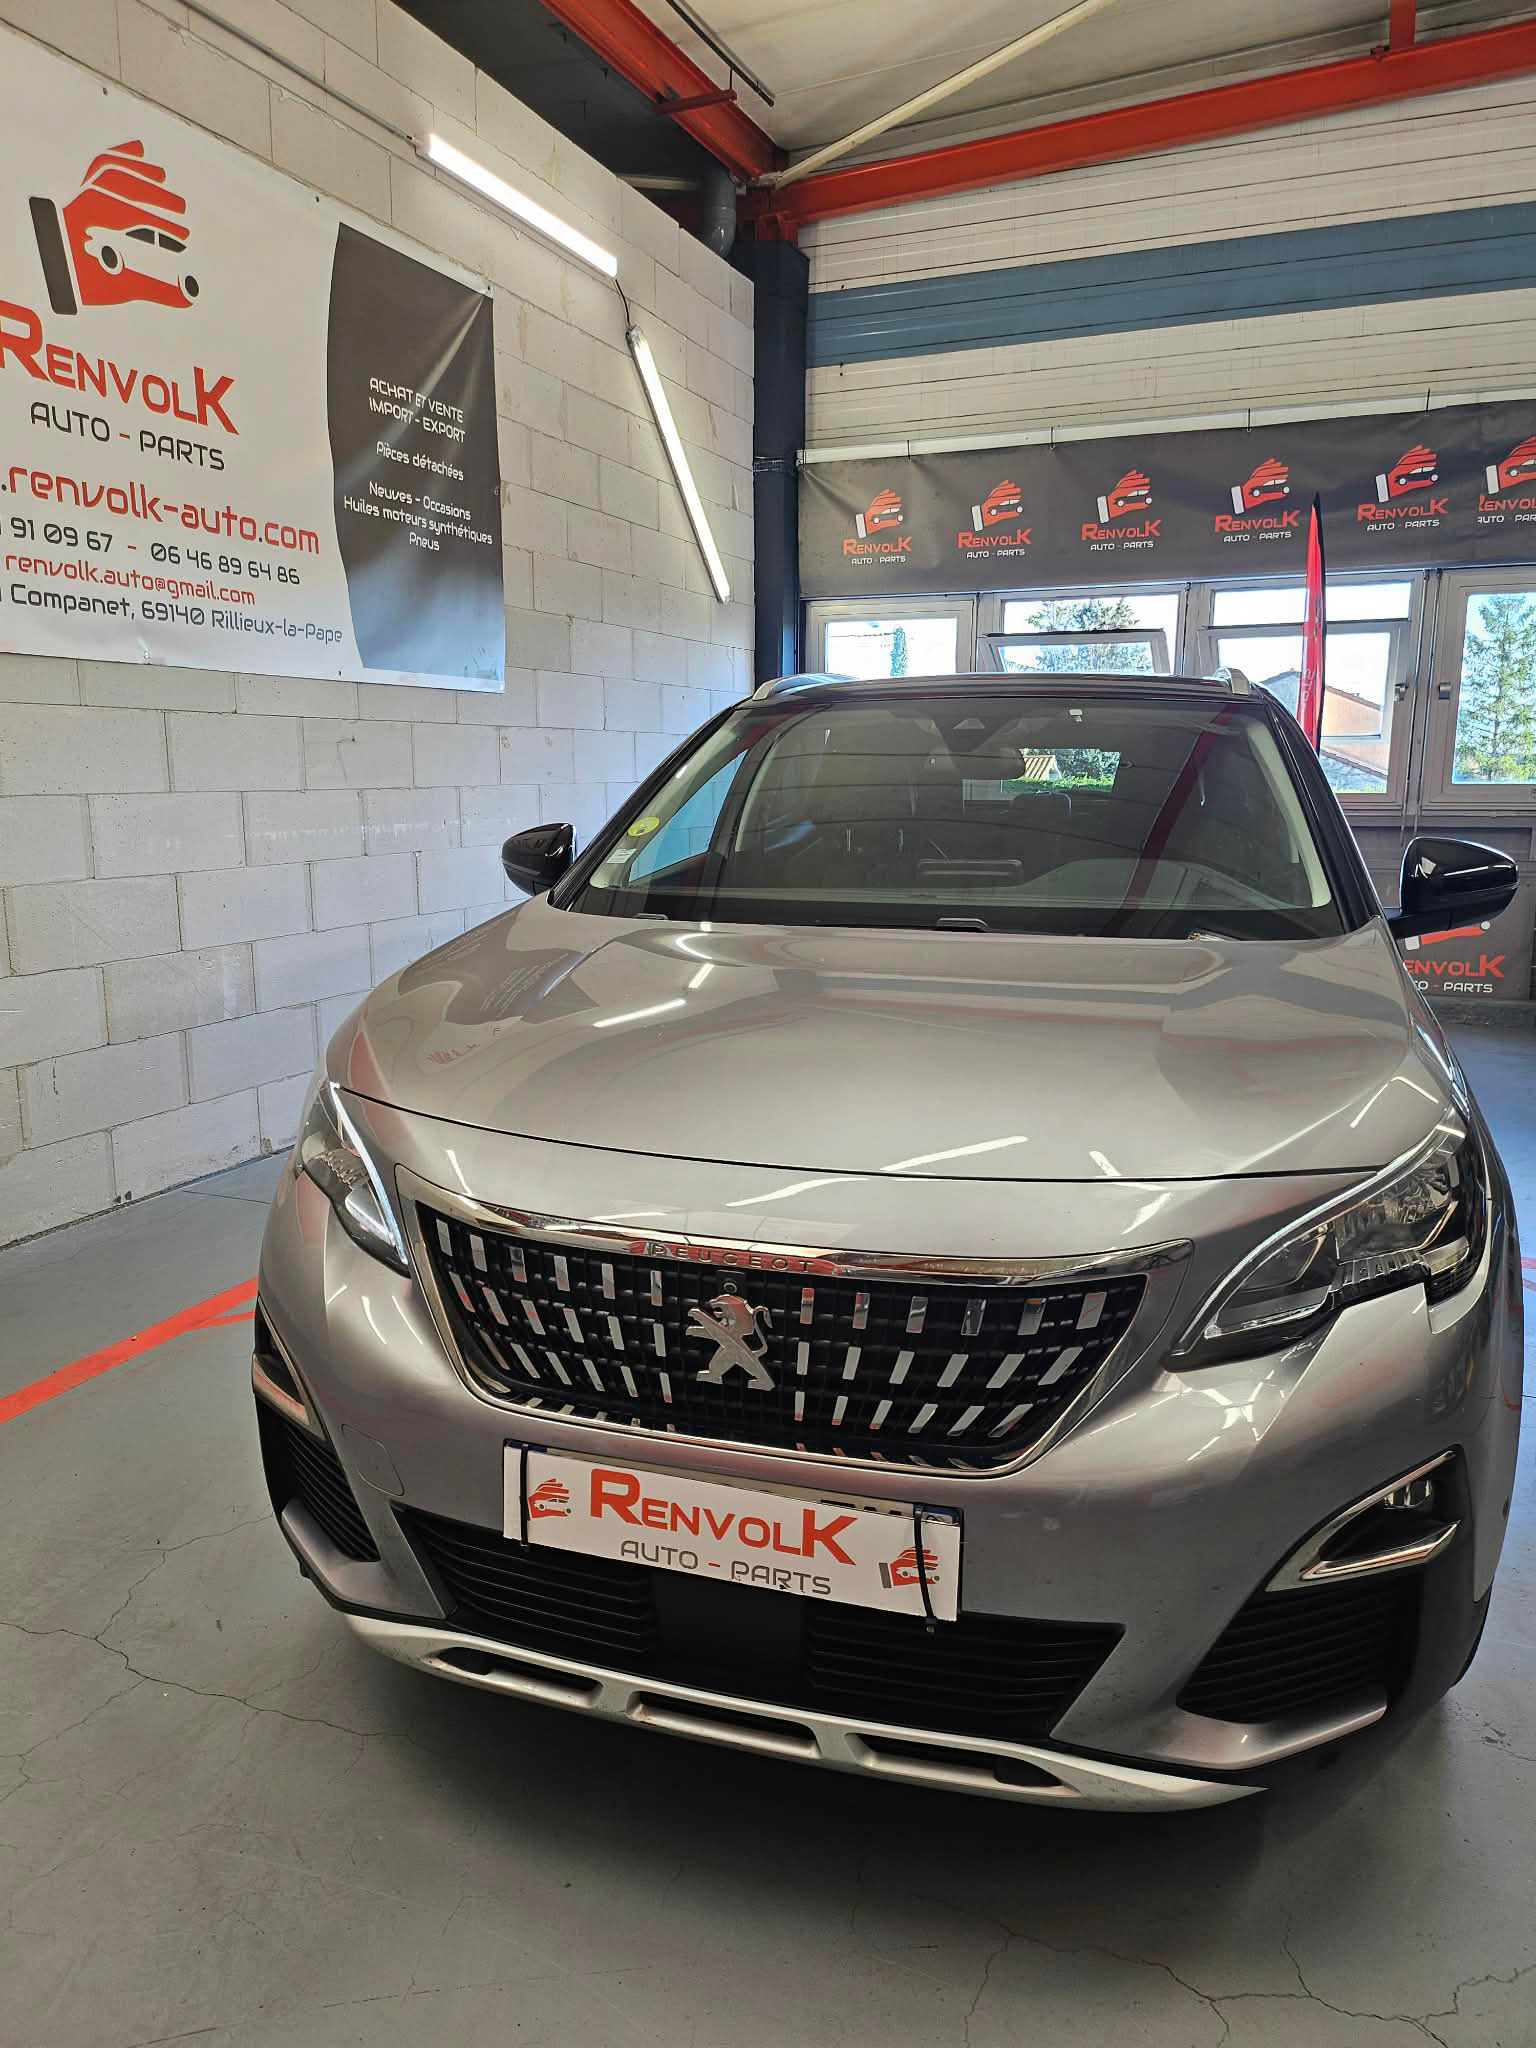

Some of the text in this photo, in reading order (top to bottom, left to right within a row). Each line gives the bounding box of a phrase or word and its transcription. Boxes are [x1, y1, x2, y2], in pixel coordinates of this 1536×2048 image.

[0, 300, 240, 435] RENVOLK
[369, 377, 464, 423] ACHAT ET VENTE
[369, 397, 414, 424] IMPORT
[423, 417, 466, 443] EXPORT
[31, 402, 110, 442] AUTO
[139, 430, 225, 471] PARTS
[376, 441, 464, 481] Pièces détachées
[369, 481, 413, 504] Neuves
[423, 496, 472, 521] Occasions
[1356, 498, 1448, 522] RENVOLK
[344, 495, 493, 545] Huiles moteurs synthétiques
[1081, 520, 1161, 541] RENVOLK
[1214, 510, 1300, 533] RENVOLK
[1367, 523, 1395, 531] AUTO
[1405, 520, 1440, 529] PARTS
[11, 517, 34, 540] 91
[44, 523, 78, 546] 09
[87, 531, 113, 552] 67
[151, 543, 181, 564] 06
[186, 549, 212, 570] 46
[218, 555, 242, 575] 89
[248, 561, 272, 580] 64
[277, 566, 300, 584] 86
[409, 532, 440, 550] Pneus
[842, 536, 912, 555] RENVOLK
[957, 528, 1032, 549] RENVOLK
[1090, 543, 1115, 551] AUTO
[1123, 541, 1154, 550] PARTS
[1223, 534, 1250, 543] AUTO
[1259, 531, 1292, 541] PARTS
[851, 557, 873, 565] AUTO
[879, 555, 906, 564] PARTS
[966, 550, 989, 559] AUTO
[996, 548, 1025, 557] PARTS
[6, 555, 256, 605] renvolk.auto@gmail.com
[11, 584, 343, 644] Companet, 69140 Rillieux-la-Pape
[1403, 954, 1505, 978] ENVOLK
[1443, 982, 1493, 993] PARTS
[651, 1242, 815, 1272] PEUGEOT
[590, 1468, 858, 1566] RENVOLK
[620, 1540, 699, 1570] AUTO
[731, 1560, 832, 1596] PARTS
